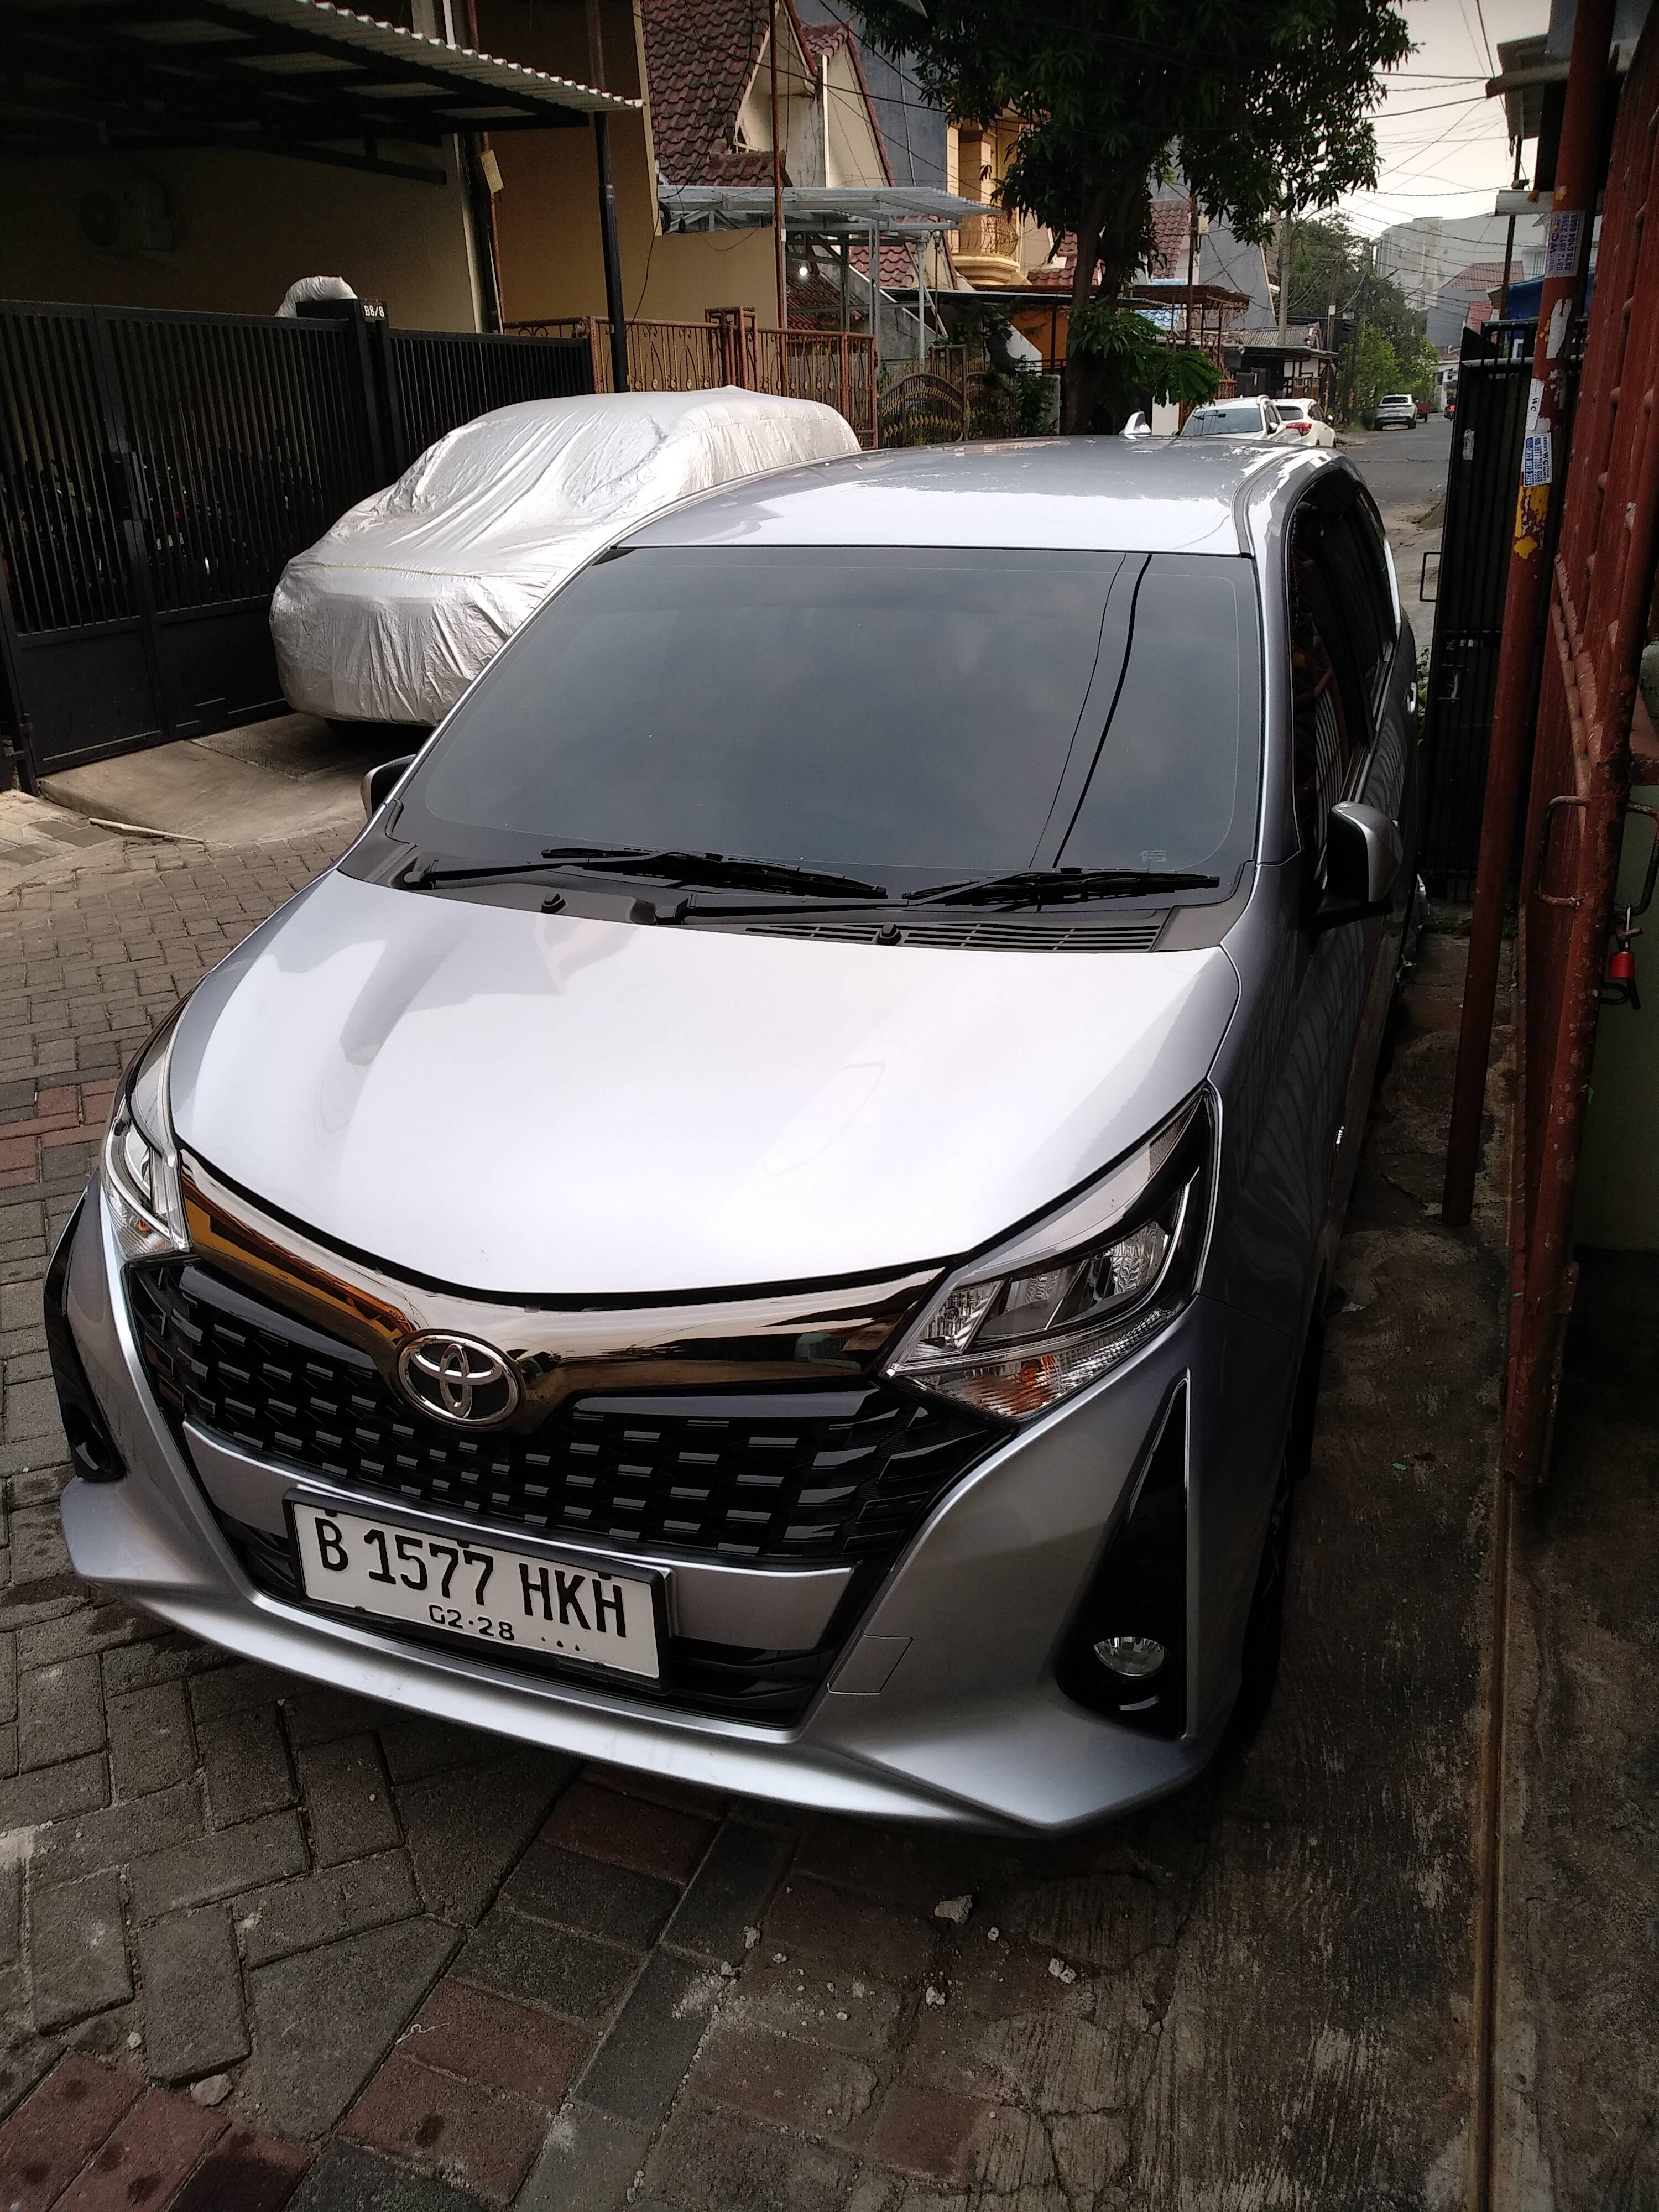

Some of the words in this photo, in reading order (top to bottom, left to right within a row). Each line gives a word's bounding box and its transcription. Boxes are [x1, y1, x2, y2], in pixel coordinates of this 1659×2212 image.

[363, 305, 385, 318] B8/8
[1530, 397, 1538, 412] WC
[1543, 451, 1549, 465] WC
[315, 1517, 348, 1572] B
[363, 1528, 494, 1606] 1577
[518, 1563, 627, 1638] HKH
